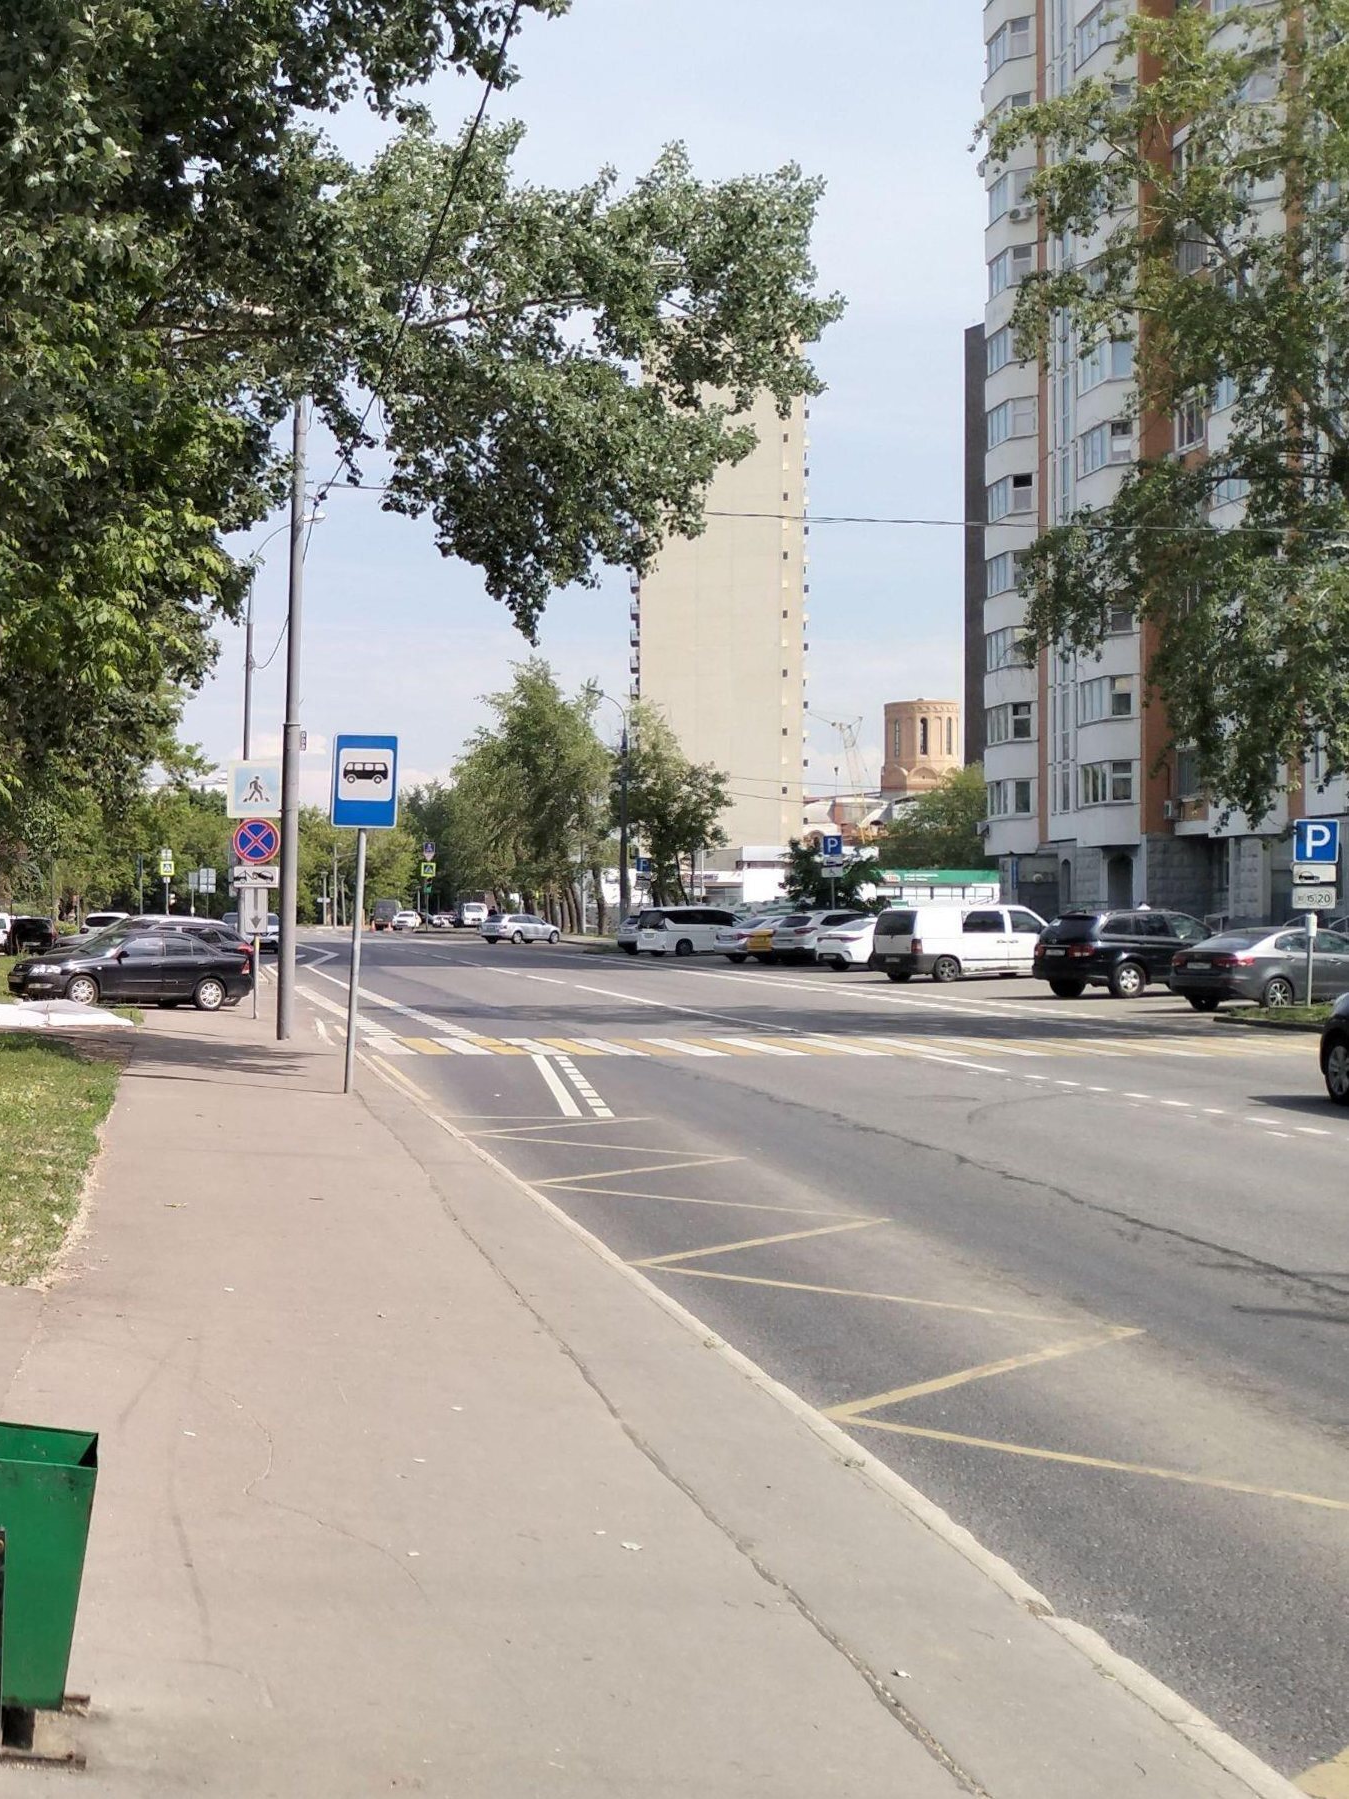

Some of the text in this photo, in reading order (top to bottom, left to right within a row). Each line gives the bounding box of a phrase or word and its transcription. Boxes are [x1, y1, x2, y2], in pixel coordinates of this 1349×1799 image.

[827, 837, 839, 854] P
[1306, 825, 1331, 858] P
[1318, 894, 1331, 903] 20
